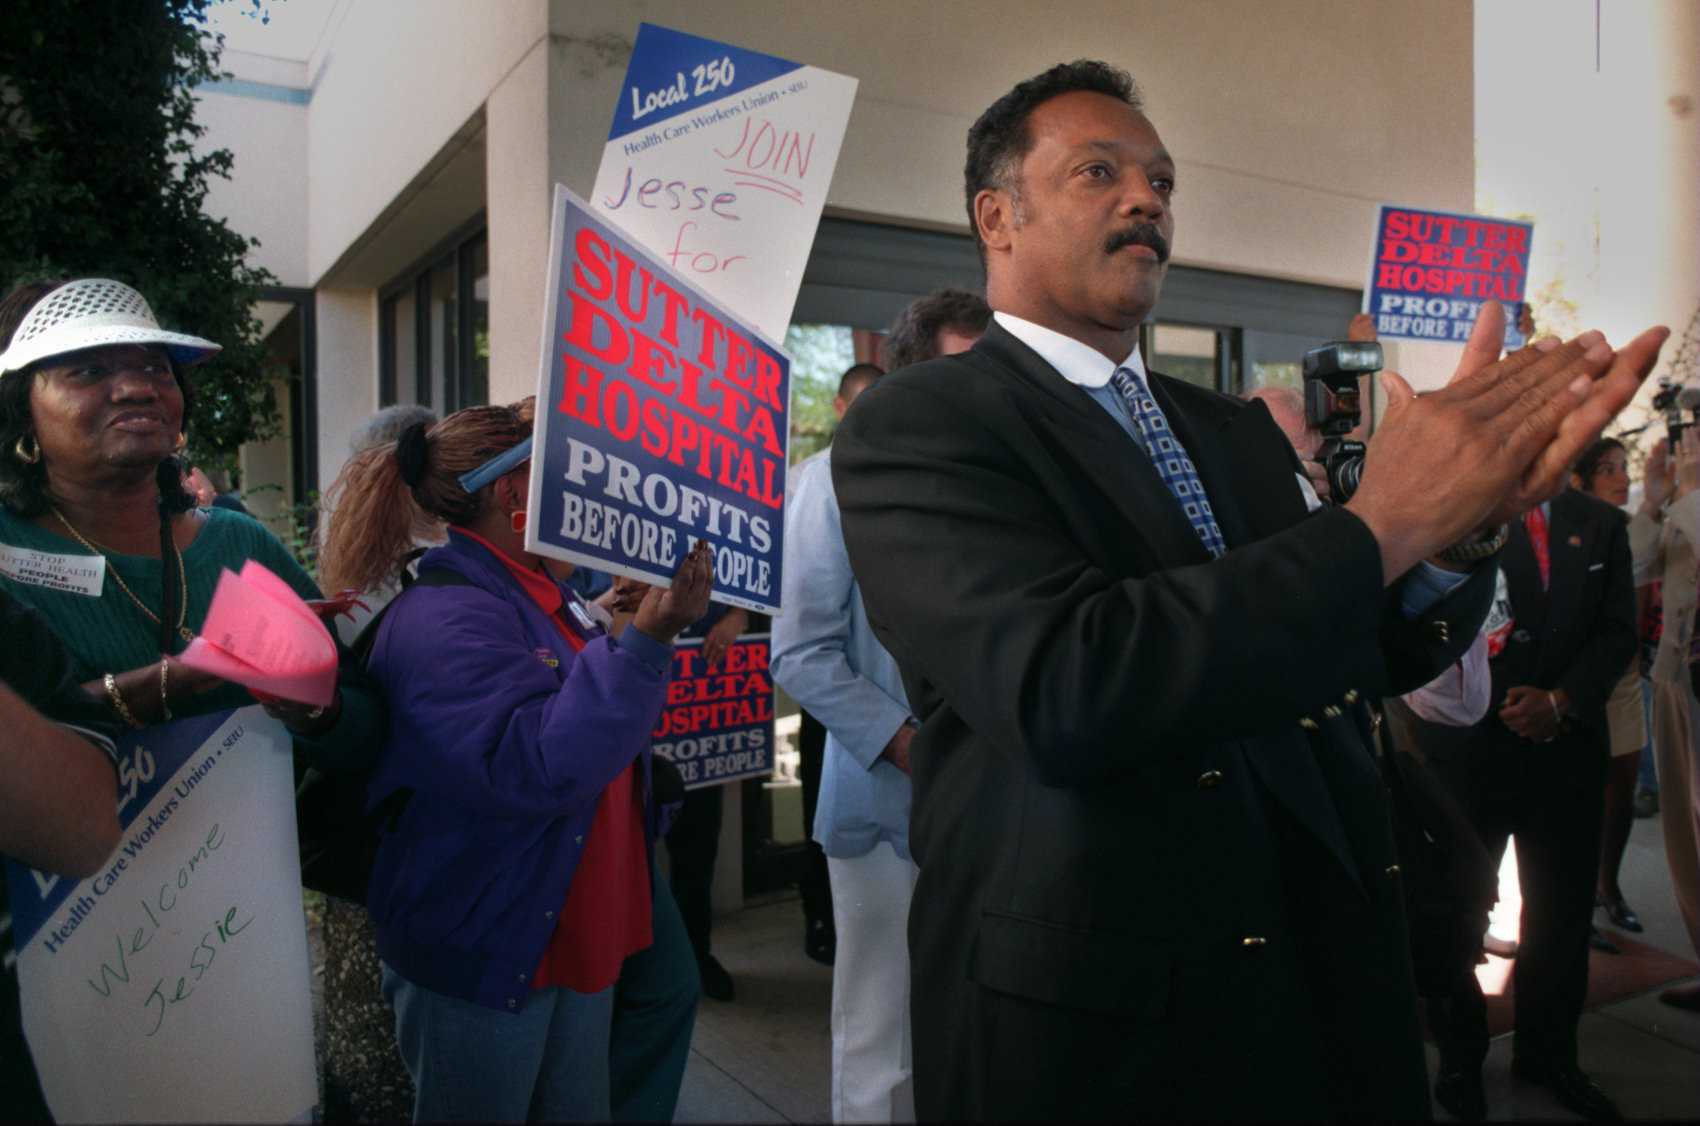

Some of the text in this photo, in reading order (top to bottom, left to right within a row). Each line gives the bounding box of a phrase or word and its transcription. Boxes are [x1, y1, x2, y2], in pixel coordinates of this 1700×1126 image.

[631, 56, 735, 120] Local 250
[623, 134, 662, 156] Health
[663, 121, 690, 142] Care
[692, 105, 742, 130] Workers
[742, 90, 780, 112] Union
[713, 116, 815, 180] JOIN
[603, 166, 740, 221] Jesse
[667, 221, 750, 273] for
[1380, 238, 1526, 275] DELTA
[1384, 211, 1527, 253] SUTTER
[1376, 263, 1523, 302] HOSPITAL
[1380, 293, 1515, 324] PROFIS
[572, 227, 784, 412] SUTTER
[1377, 314, 1447, 337] BEFORE
[562, 290, 785, 459] DELTA
[557, 352, 785, 510] HOSPITAL
[564, 437, 773, 554] PROFITS
[560, 490, 677, 571] BEFORE
[19, 568, 69, 582] PEOPLE
[43, 580, 89, 593] PROFITS
[48, 564, 97, 578] HEALTH
[667, 672, 773, 705] ELTA
[115, 744, 156, 815] 50
[704, 749, 765, 778] PEOPLE
[43, 893, 97, 954] Health
[92, 854, 128, 896] Care
[124, 796, 179, 860] Workers
[175, 756, 218, 800] Union
[222, 724, 247, 752] SEIU
[88, 822, 225, 997] Welcome
[144, 906, 256, 1037] Jessie
